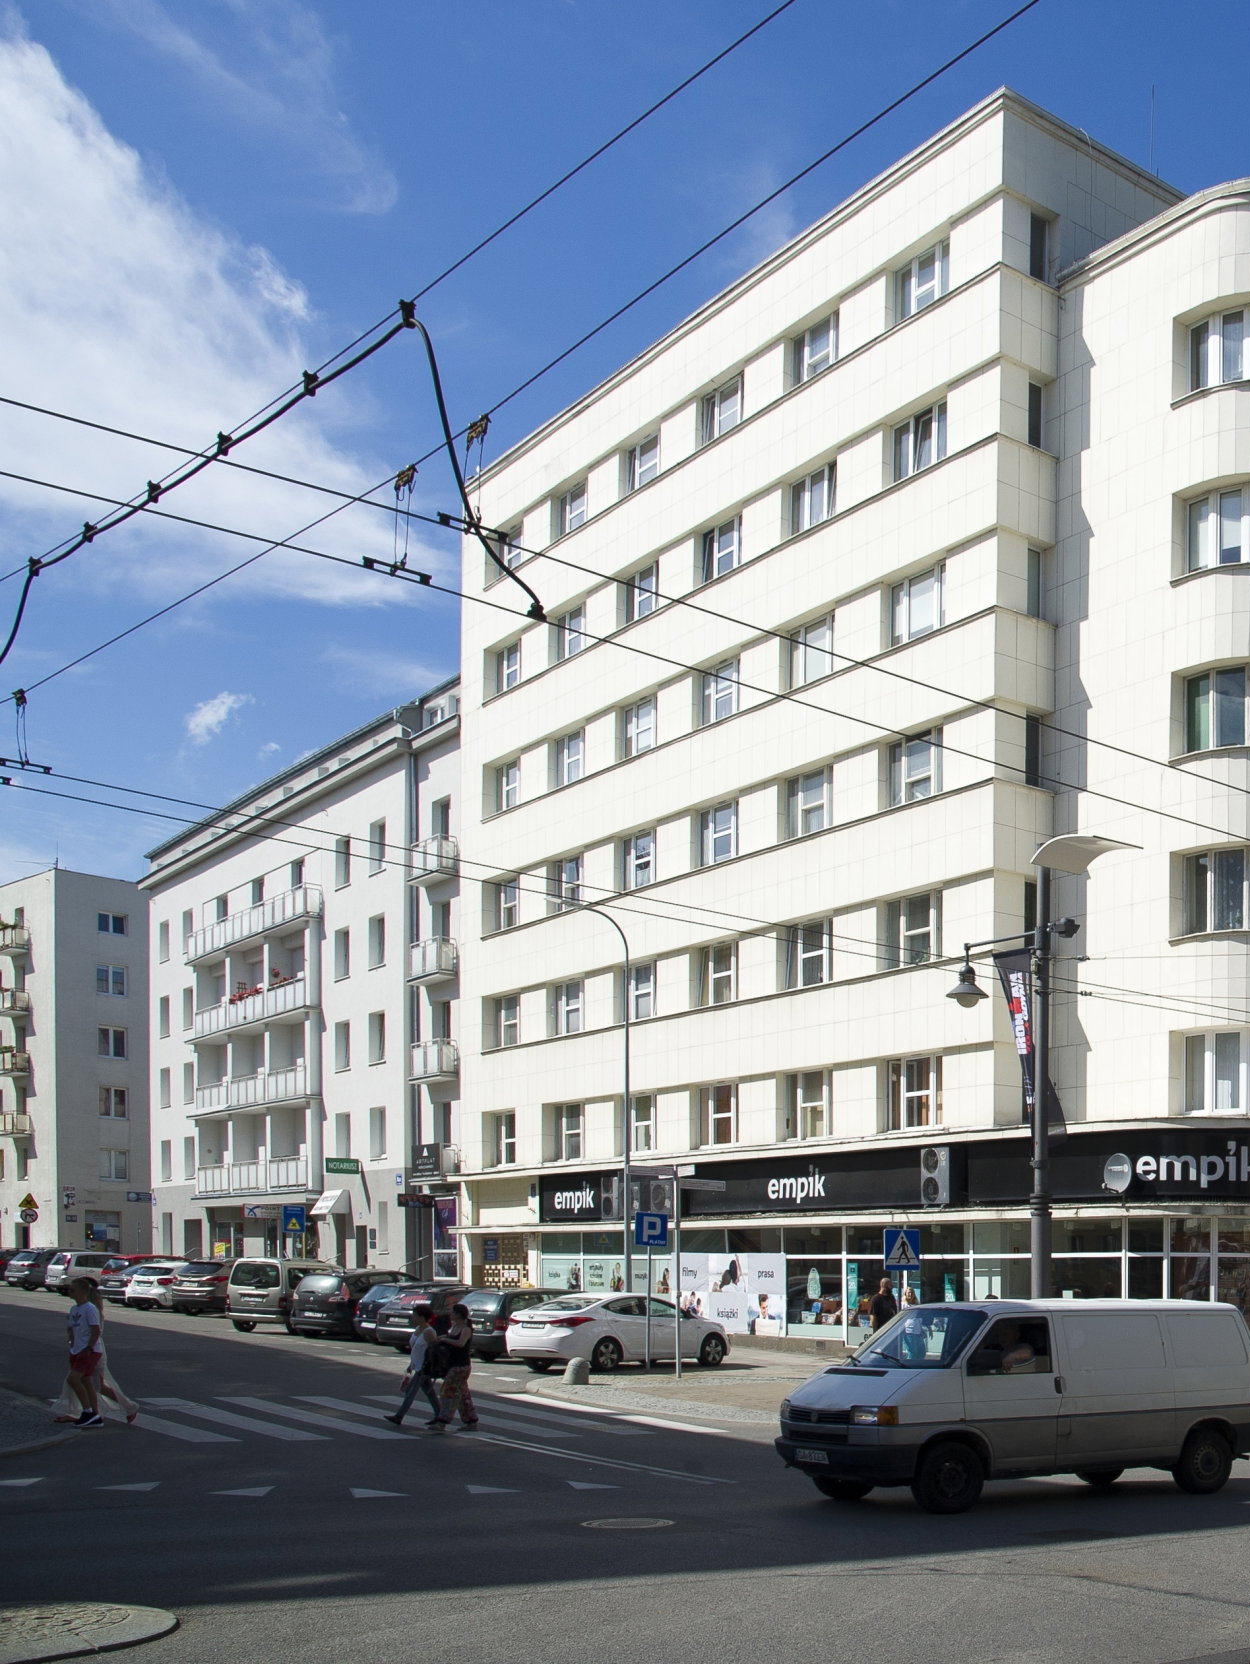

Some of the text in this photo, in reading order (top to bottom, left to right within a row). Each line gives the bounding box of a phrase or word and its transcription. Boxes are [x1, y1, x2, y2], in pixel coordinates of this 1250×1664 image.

[328, 1161, 358, 1170] NOTARIUSZ
[768, 1165, 825, 1203] empik
[554, 1182, 594, 1213] empik
[682, 1266, 698, 1279] filmy
[757, 1269, 775, 1279] prasa
[717, 1308, 739, 1319] książki
